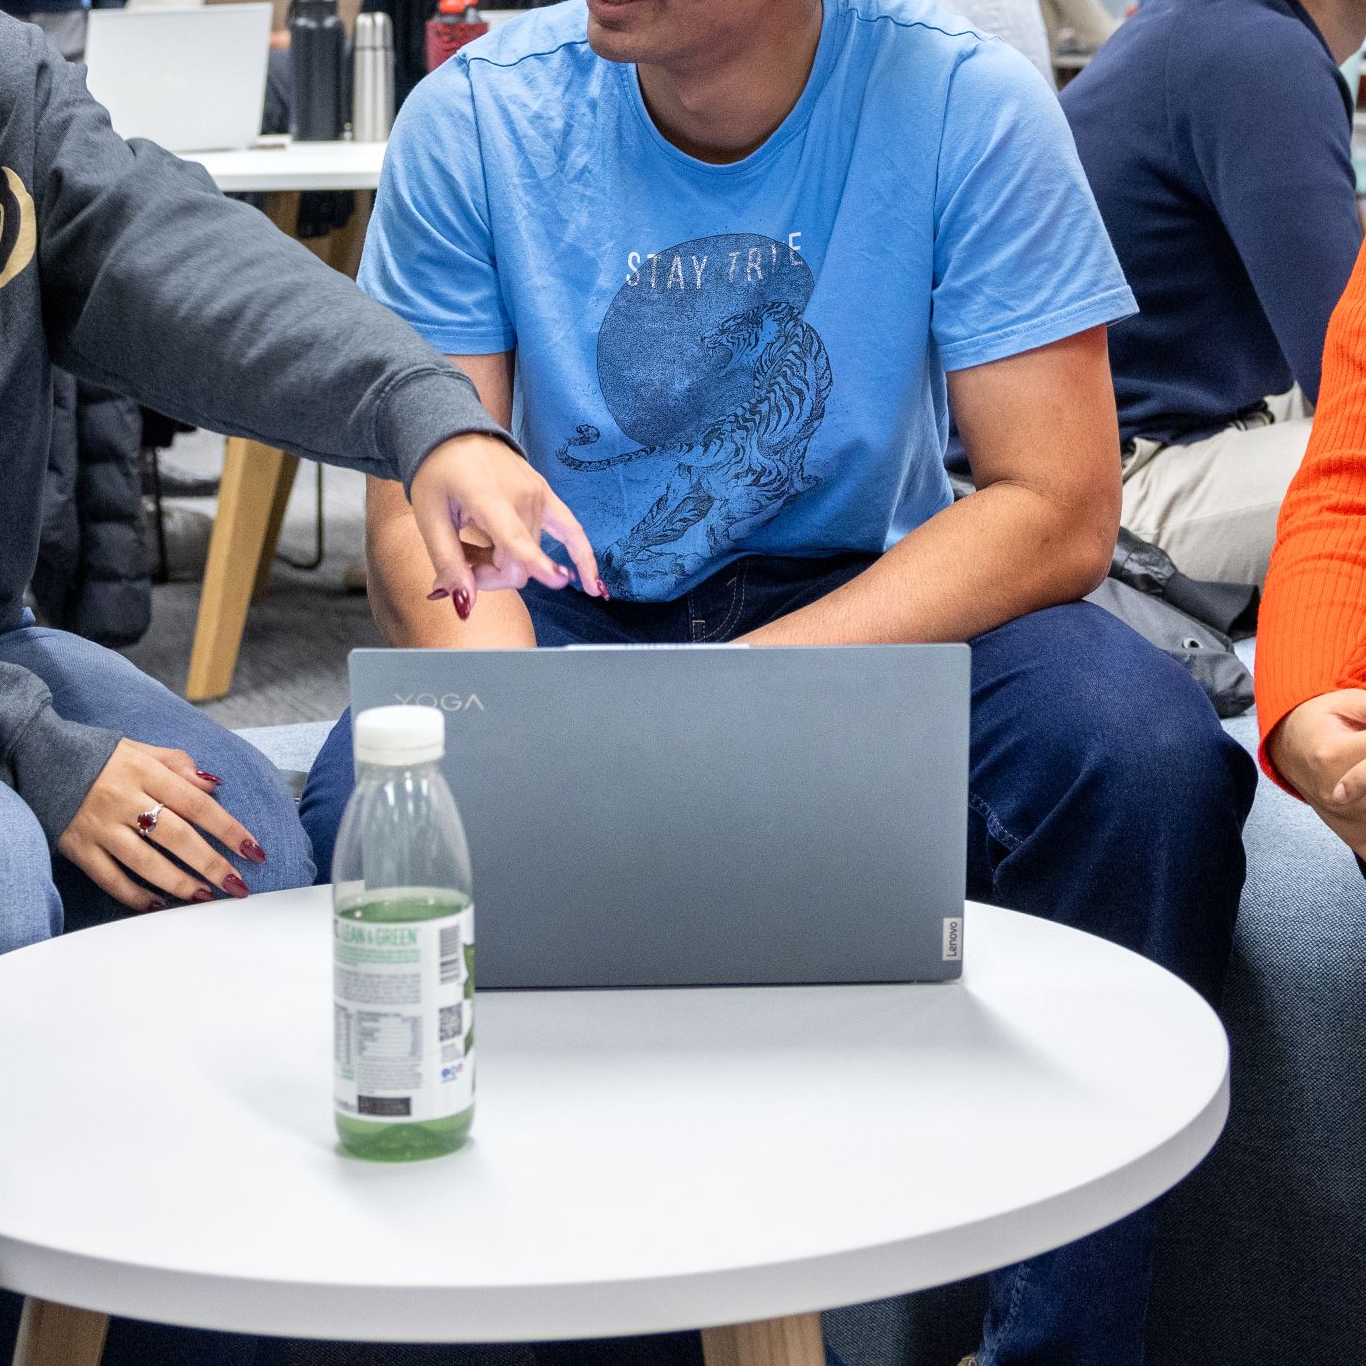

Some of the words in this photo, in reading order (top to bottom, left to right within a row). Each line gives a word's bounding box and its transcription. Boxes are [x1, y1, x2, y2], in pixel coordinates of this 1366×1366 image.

[626, 251, 708, 290] STAY
[395, 693, 485, 712] YOGA
[946, 921, 958, 957] Lenovo
